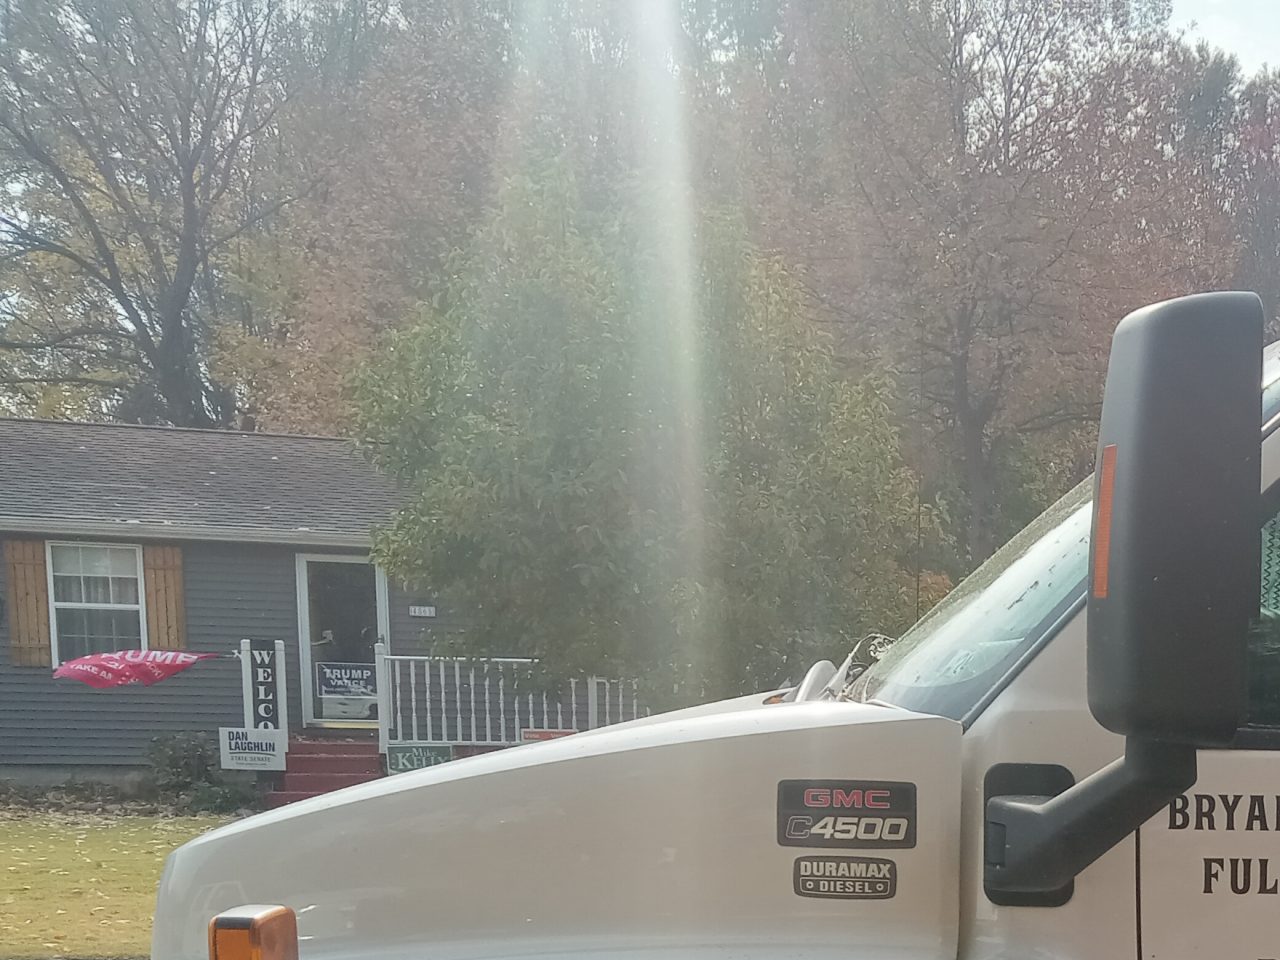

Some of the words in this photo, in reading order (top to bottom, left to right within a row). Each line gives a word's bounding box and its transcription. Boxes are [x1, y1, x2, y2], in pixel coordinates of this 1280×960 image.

[323, 668, 371, 679] TRUMP
[228, 731, 248, 741] DAN
[229, 741, 275, 752] LAUGHLIN
[804, 789, 890, 808] GMC
[786, 816, 908, 840] C4500
[801, 861, 891, 878] DURAMAX
[819, 880, 873, 892] DIESEL
